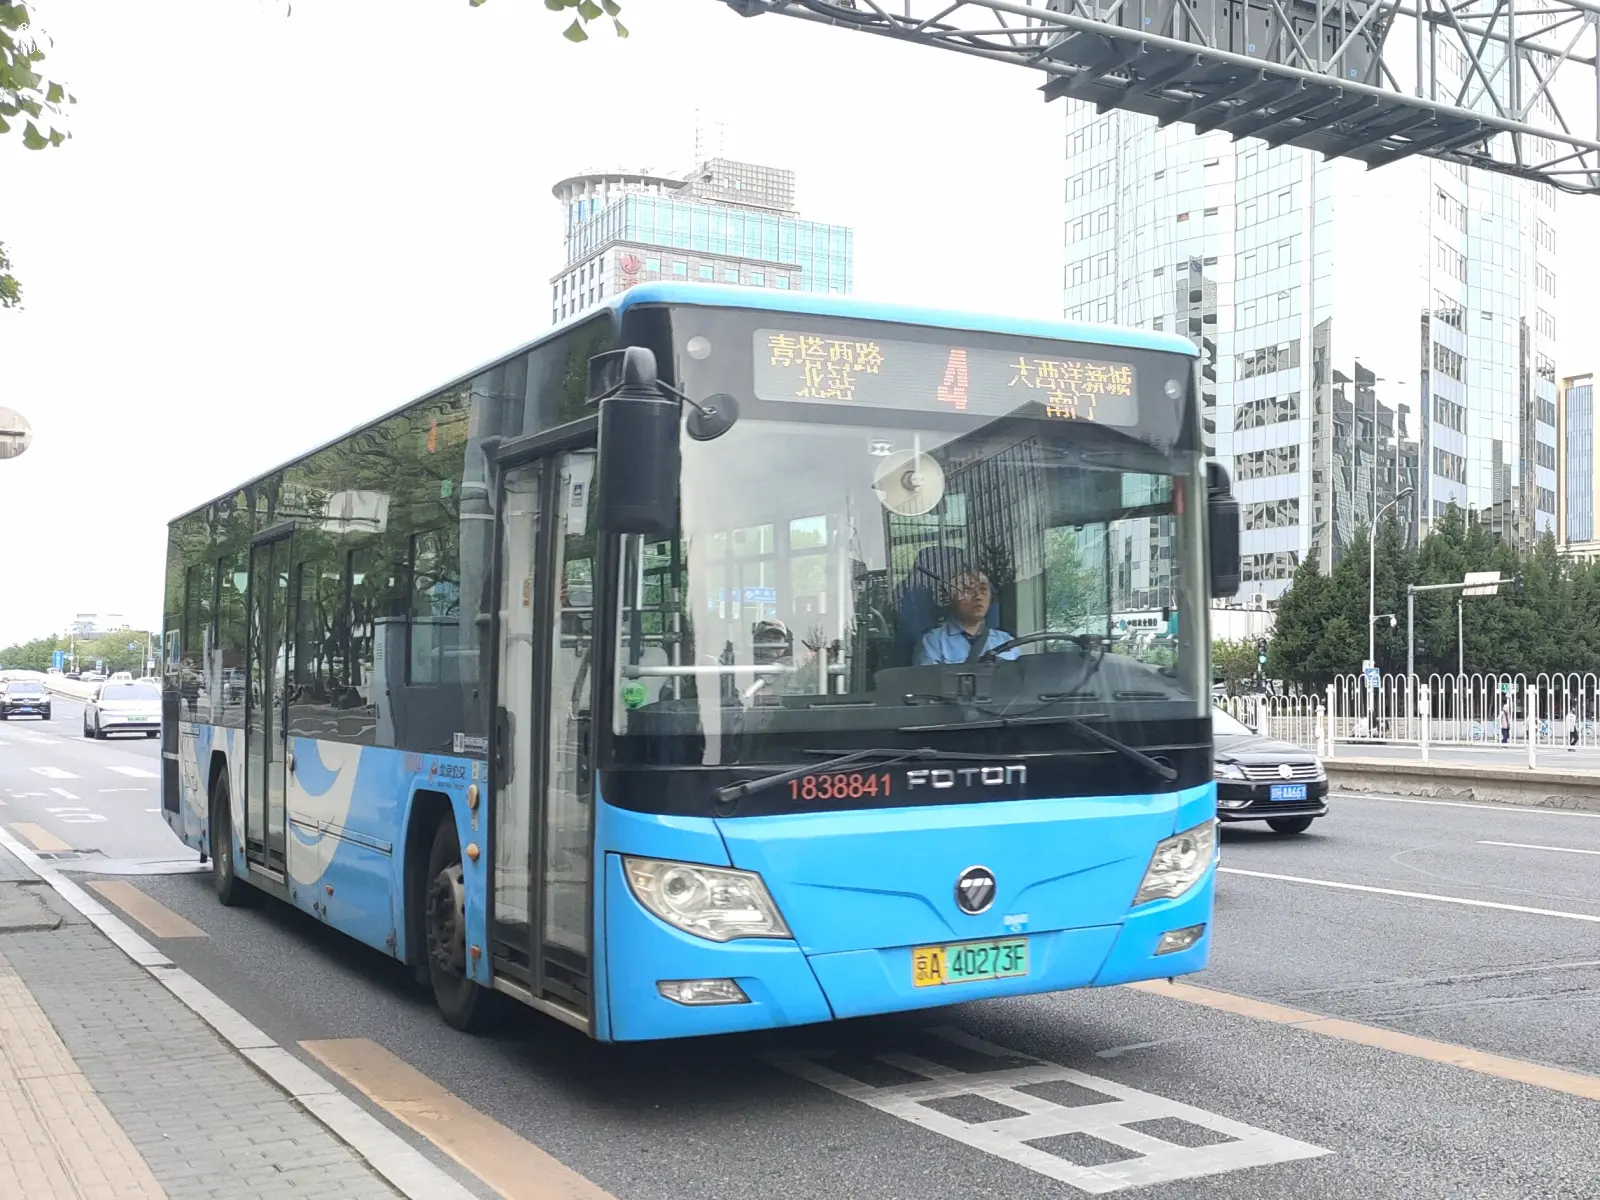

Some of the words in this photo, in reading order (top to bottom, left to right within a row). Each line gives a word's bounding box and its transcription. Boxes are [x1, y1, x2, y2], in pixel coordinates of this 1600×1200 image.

[767, 333, 885, 374] 青塔西路
[795, 364, 856, 401] 北站
[937, 348, 968, 410] 4
[1007, 356, 1133, 397] 大西洋新城
[1045, 389, 1097, 421] 南门
[787, 772, 892, 800] 1838841
[906, 764, 1027, 790] FOTON
[951, 943, 1026, 977] 40273F
